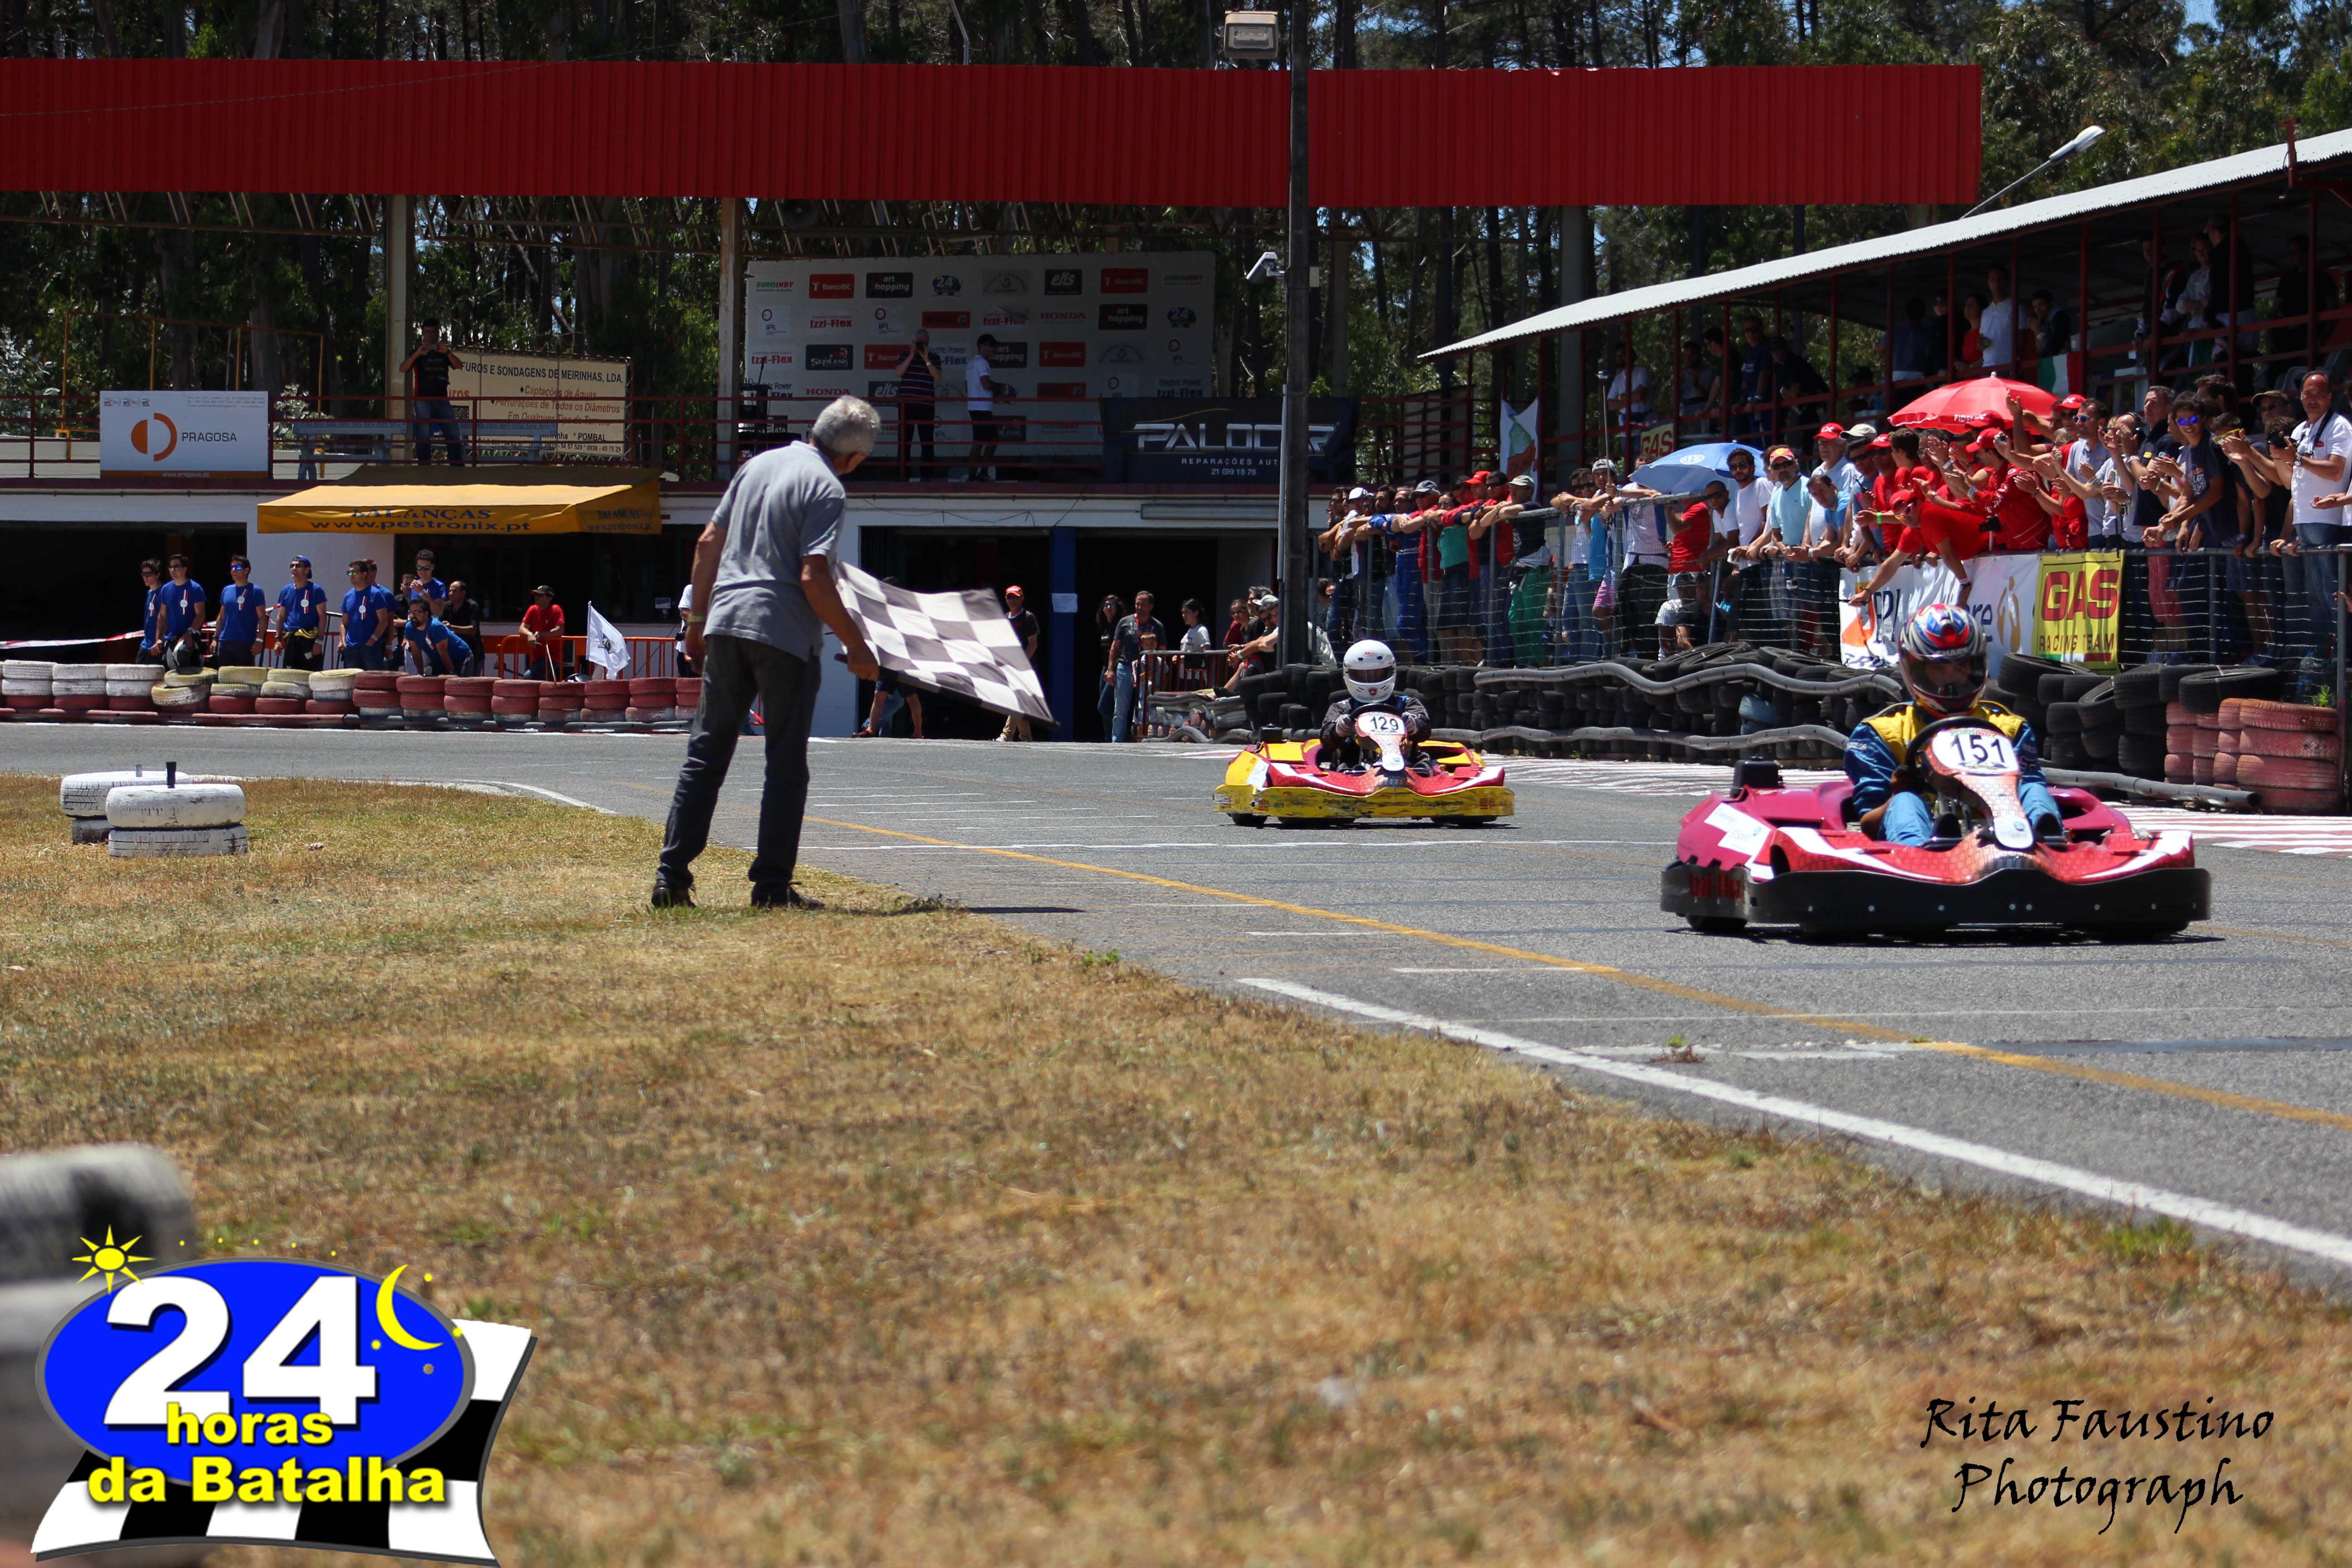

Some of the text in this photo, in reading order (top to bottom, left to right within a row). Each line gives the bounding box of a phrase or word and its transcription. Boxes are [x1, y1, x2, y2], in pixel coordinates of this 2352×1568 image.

[810, 319, 852, 328] Izzi-Flex
[751, 355, 793, 365] Izzi-Flex
[490, 365, 495, 375] E
[497, 366, 546, 378] SONDAGENS
[548, 369, 559, 379] DE
[562, 370, 604, 382] MEIRINHAS,
[607, 373, 624, 383] LDA.
[525, 385, 562, 398] Captações
[564, 389, 573, 397] de
[540, 400, 549, 409] de
[551, 399, 573, 412] Todos
[575, 403, 583, 412] os
[584, 402, 621, 414] Diâmetros
[182, 432, 237, 442] PRAGOSA
[578, 433, 606, 443] POMBAL
[1641, 430, 1672, 456] GAS
[1182, 457, 1253, 466] REPARAÇÕES
[310, 520, 530, 531] www.pestronix.pt
[2041, 569, 2119, 621] GAS
[2039, 633, 2115, 652] RACING TEAM
[1370, 716, 1399, 730] 129
[1950, 735, 2005, 764] 151
